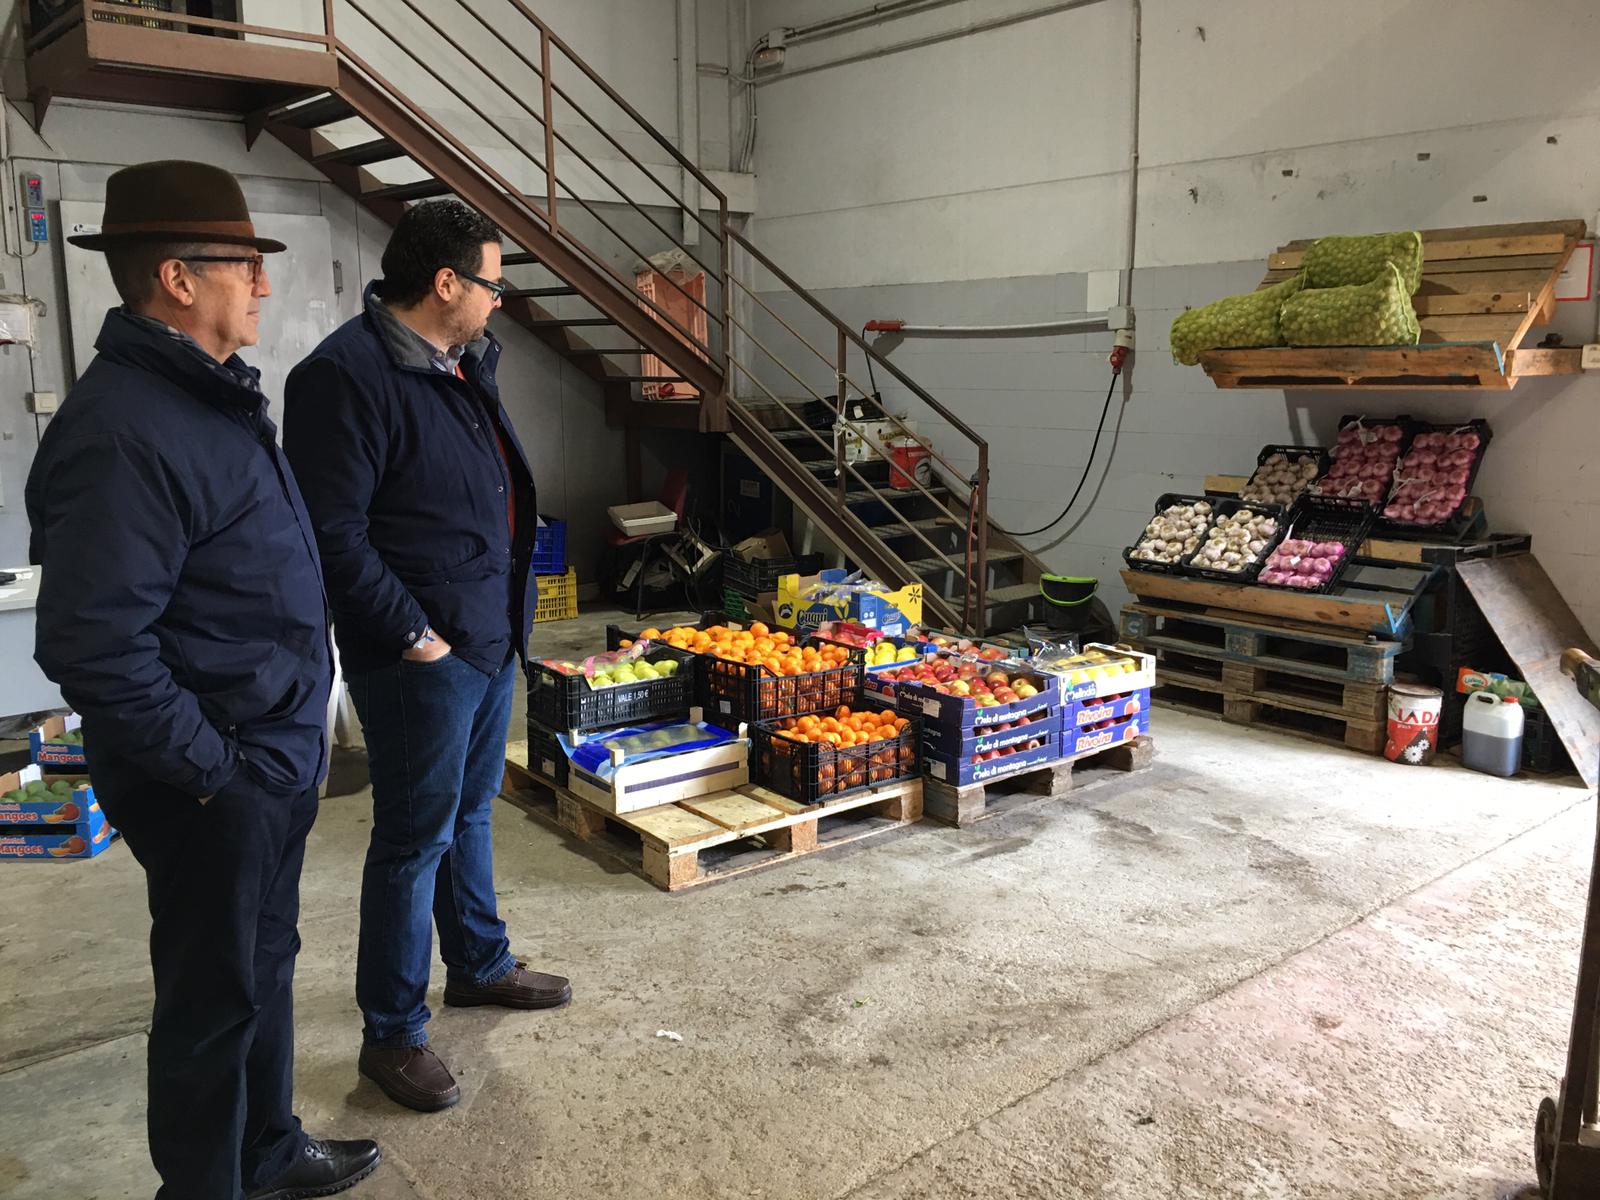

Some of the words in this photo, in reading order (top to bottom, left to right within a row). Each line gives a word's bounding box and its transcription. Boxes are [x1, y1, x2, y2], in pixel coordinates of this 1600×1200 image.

[617, 692, 632, 703] VALE
[975, 713, 992, 725] Mela
[992, 713, 999, 723] di
[1076, 706, 1114, 726] Rivoira
[975, 741, 993, 753] Mela
[993, 740, 999, 751] di
[1000, 734, 1028, 747] montagna
[1075, 732, 1113, 752] Rivoira
[37, 752, 86, 764] Mangoes
[973, 768, 990, 780] Mela
[991, 766, 997, 776] di
[998, 760, 1027, 774] montagna
[0, 812, 38, 823] angoes
